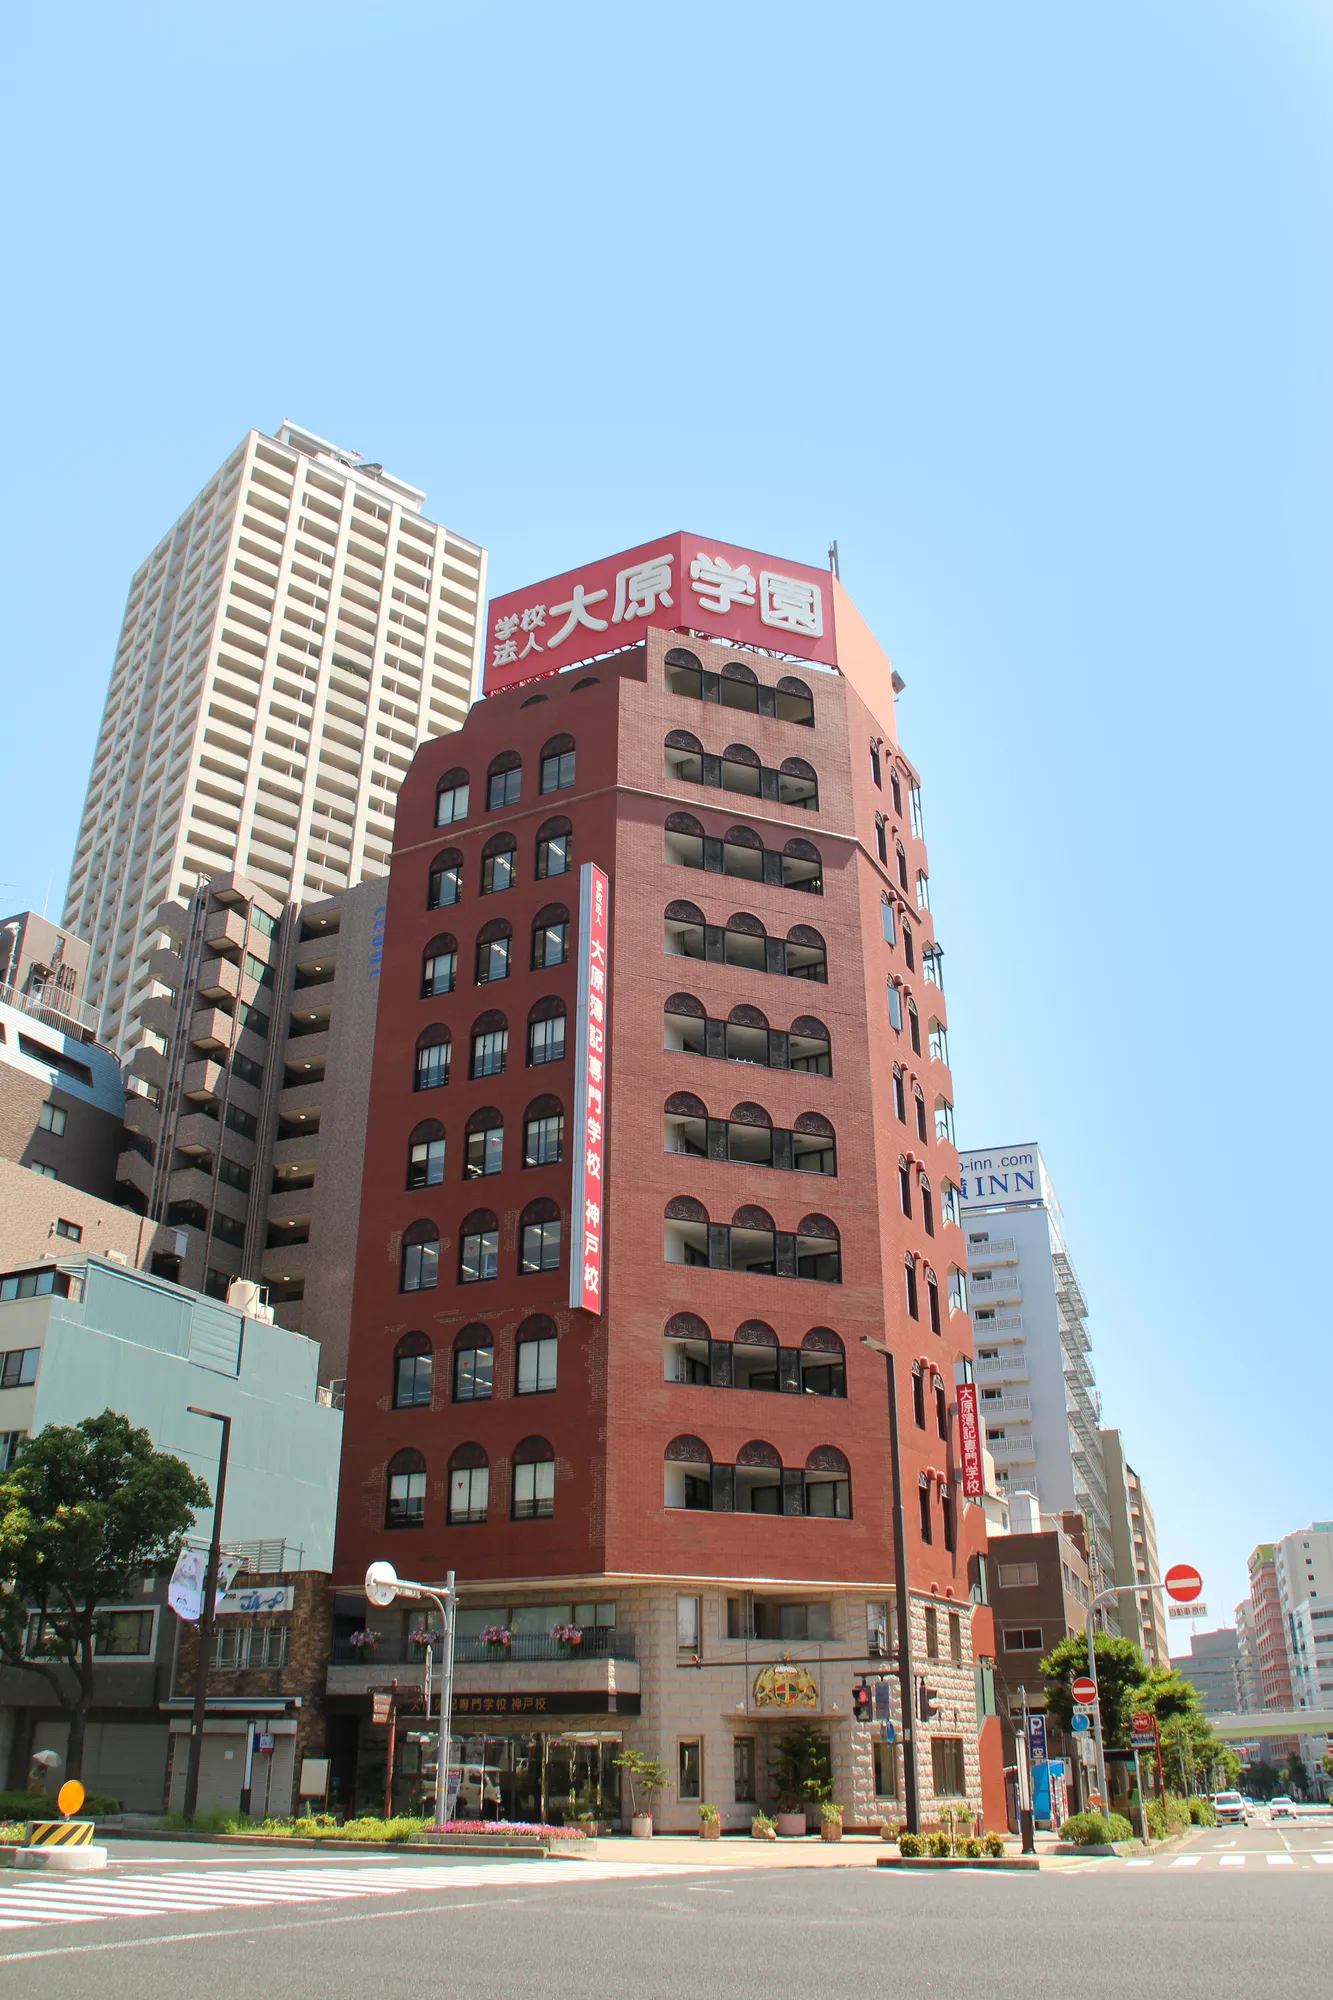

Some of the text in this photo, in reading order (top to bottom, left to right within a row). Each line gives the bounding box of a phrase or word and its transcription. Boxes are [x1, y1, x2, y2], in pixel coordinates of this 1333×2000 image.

[494, 604, 546, 640] 学校
[492, 632, 544, 667] 法人
[583, 1198, 600, 1295] 神戸校
[960, 1387, 981, 1494] 大原簿記専門学校
[511, 1697, 546, 1711] 神戸校
